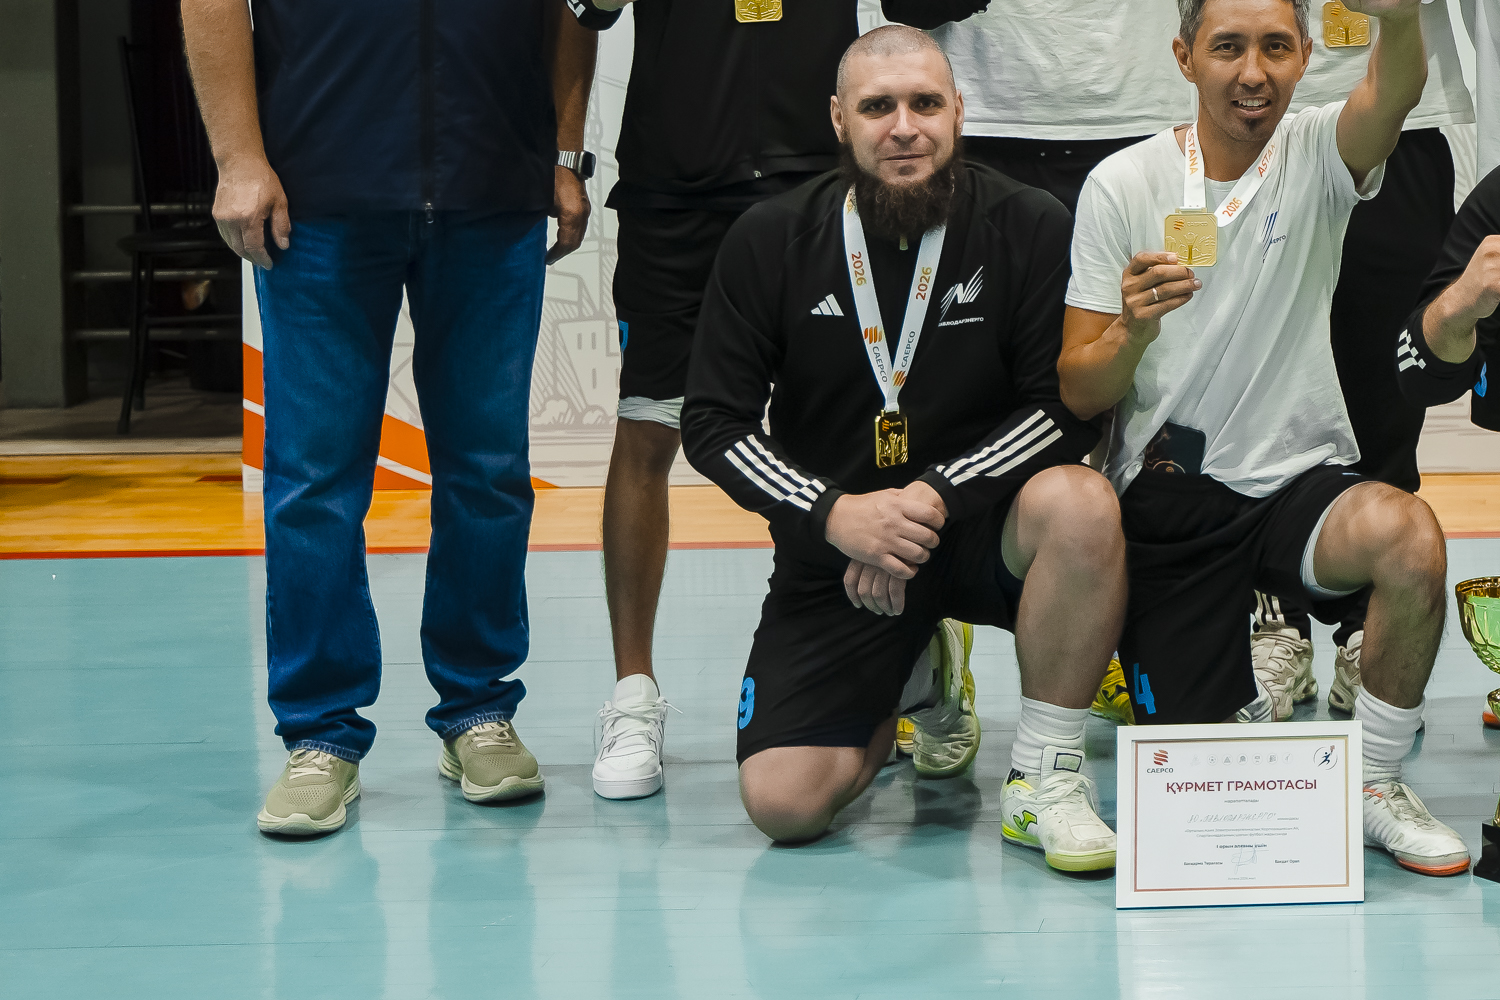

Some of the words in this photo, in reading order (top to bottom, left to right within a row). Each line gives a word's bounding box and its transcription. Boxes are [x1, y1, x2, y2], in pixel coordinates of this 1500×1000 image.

[1222, 197, 1243, 218] 2026
[851, 251, 867, 287] 2026
[915, 266, 933, 301] 2026
[872, 345, 888, 383] CAEPCO
[901, 330, 916, 368] CAEPCO
[737, 676, 756, 730] 9
[1133, 662, 1157, 715] 4
[1166, 781, 1223, 794] ҚҰРМЕТ
[1227, 779, 1317, 792] ГРАМОТАСЫ
